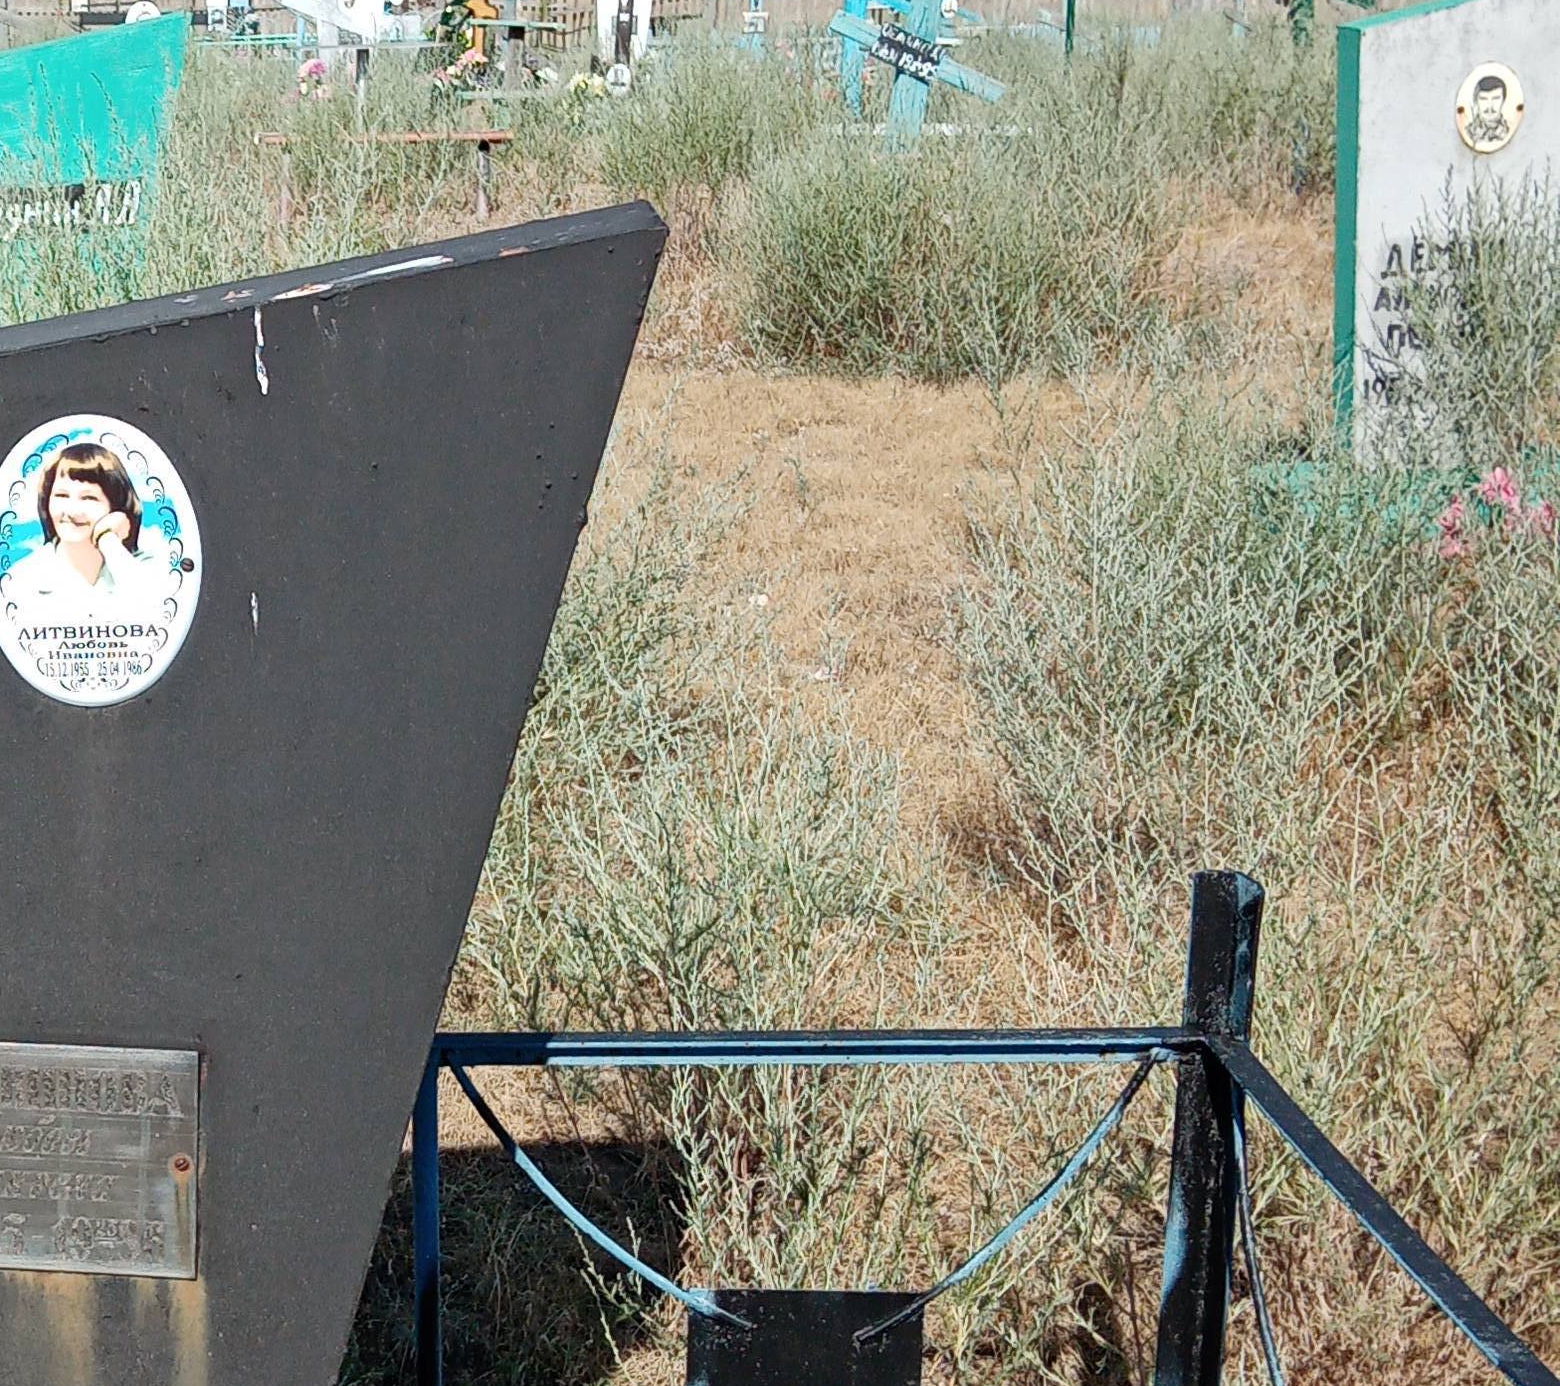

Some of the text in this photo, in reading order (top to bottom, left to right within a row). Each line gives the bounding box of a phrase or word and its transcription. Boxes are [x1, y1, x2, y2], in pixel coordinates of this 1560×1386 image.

[17, 624, 159, 640] ЛИТВИНОВА
[58, 639, 128, 649] Любовь
[48, 650, 139, 660] Ивановна
